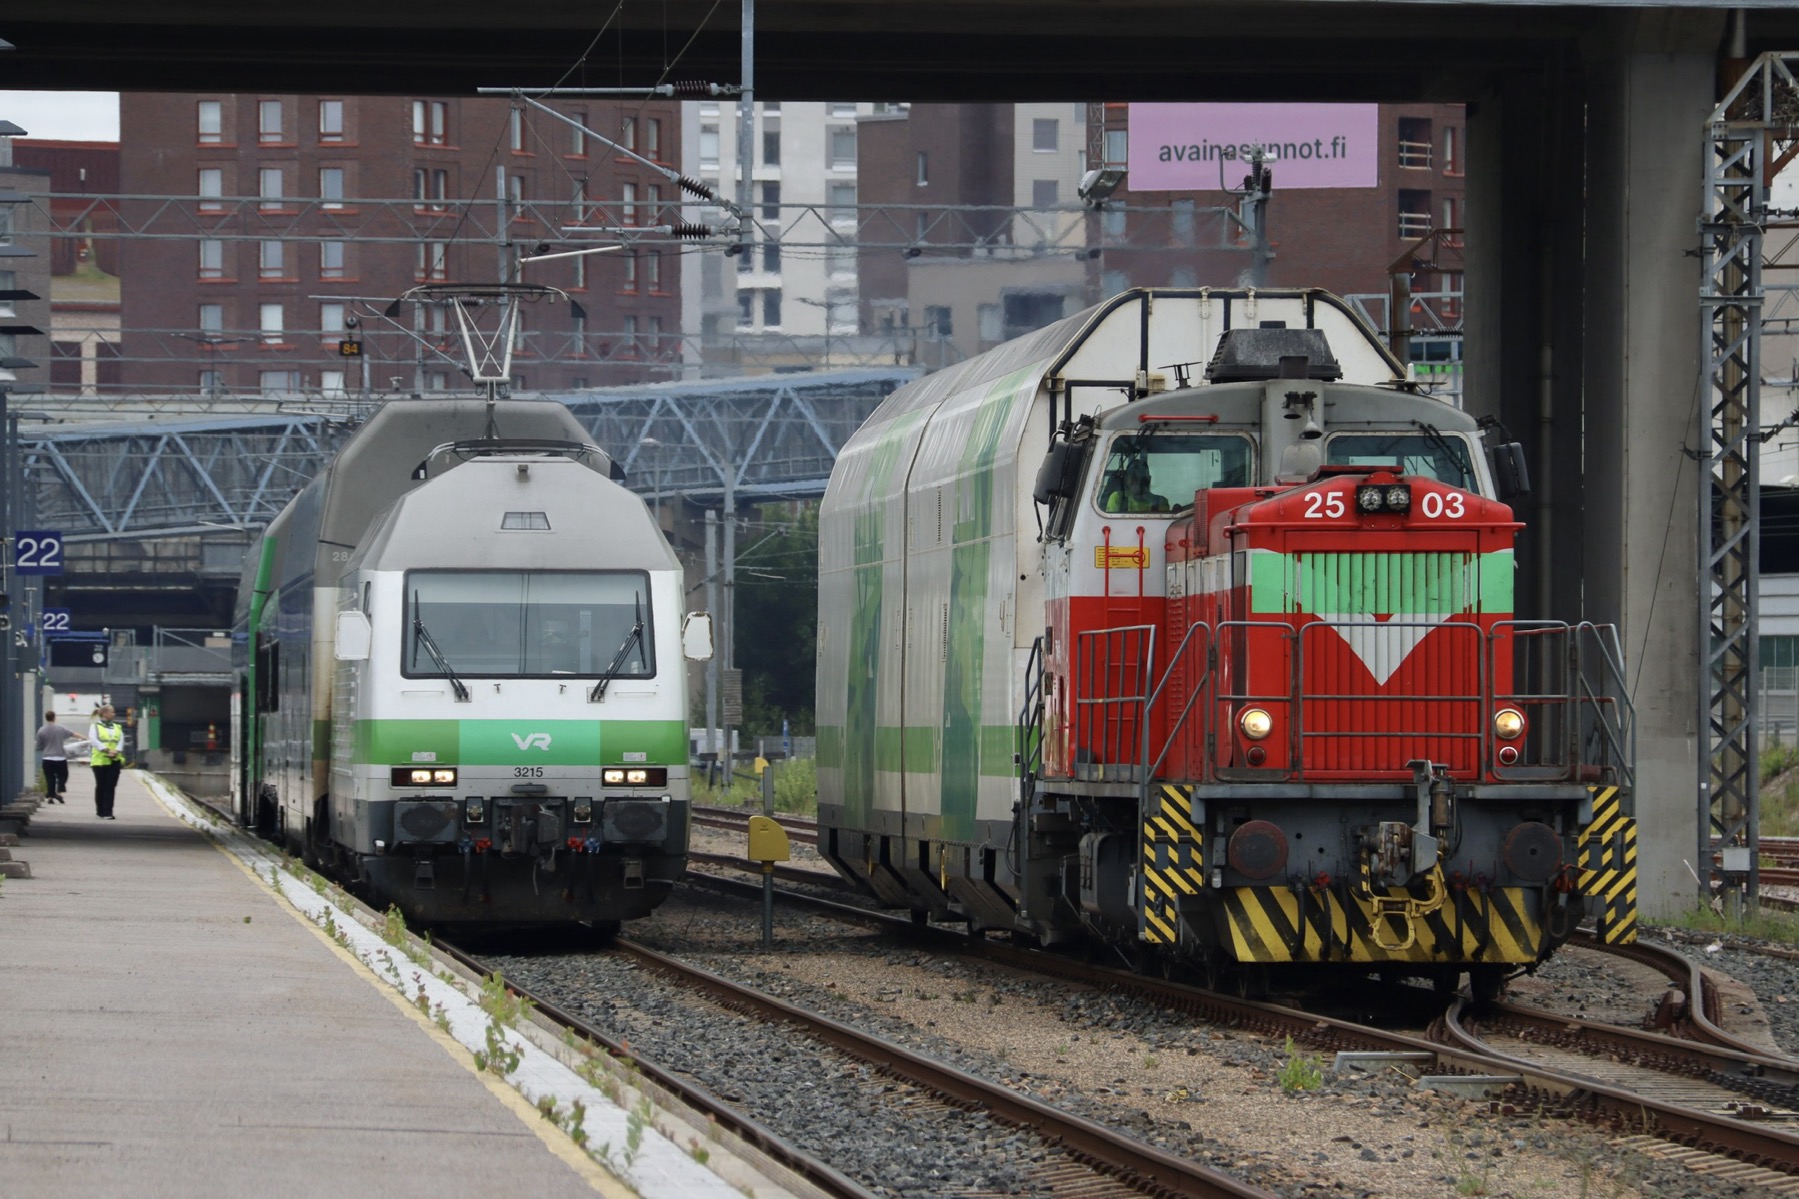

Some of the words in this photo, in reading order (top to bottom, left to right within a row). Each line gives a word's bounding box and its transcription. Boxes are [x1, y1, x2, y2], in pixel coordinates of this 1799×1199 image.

[1159, 136, 1346, 162] avainasnnot.fi
[343, 343, 358, 354] 84
[1304, 491, 1345, 519] 25
[1421, 491, 1466, 519] 03
[17, 538, 60, 567] 22
[43, 612, 69, 630] 22
[511, 732, 552, 751] VR
[513, 766, 544, 778] 3215
